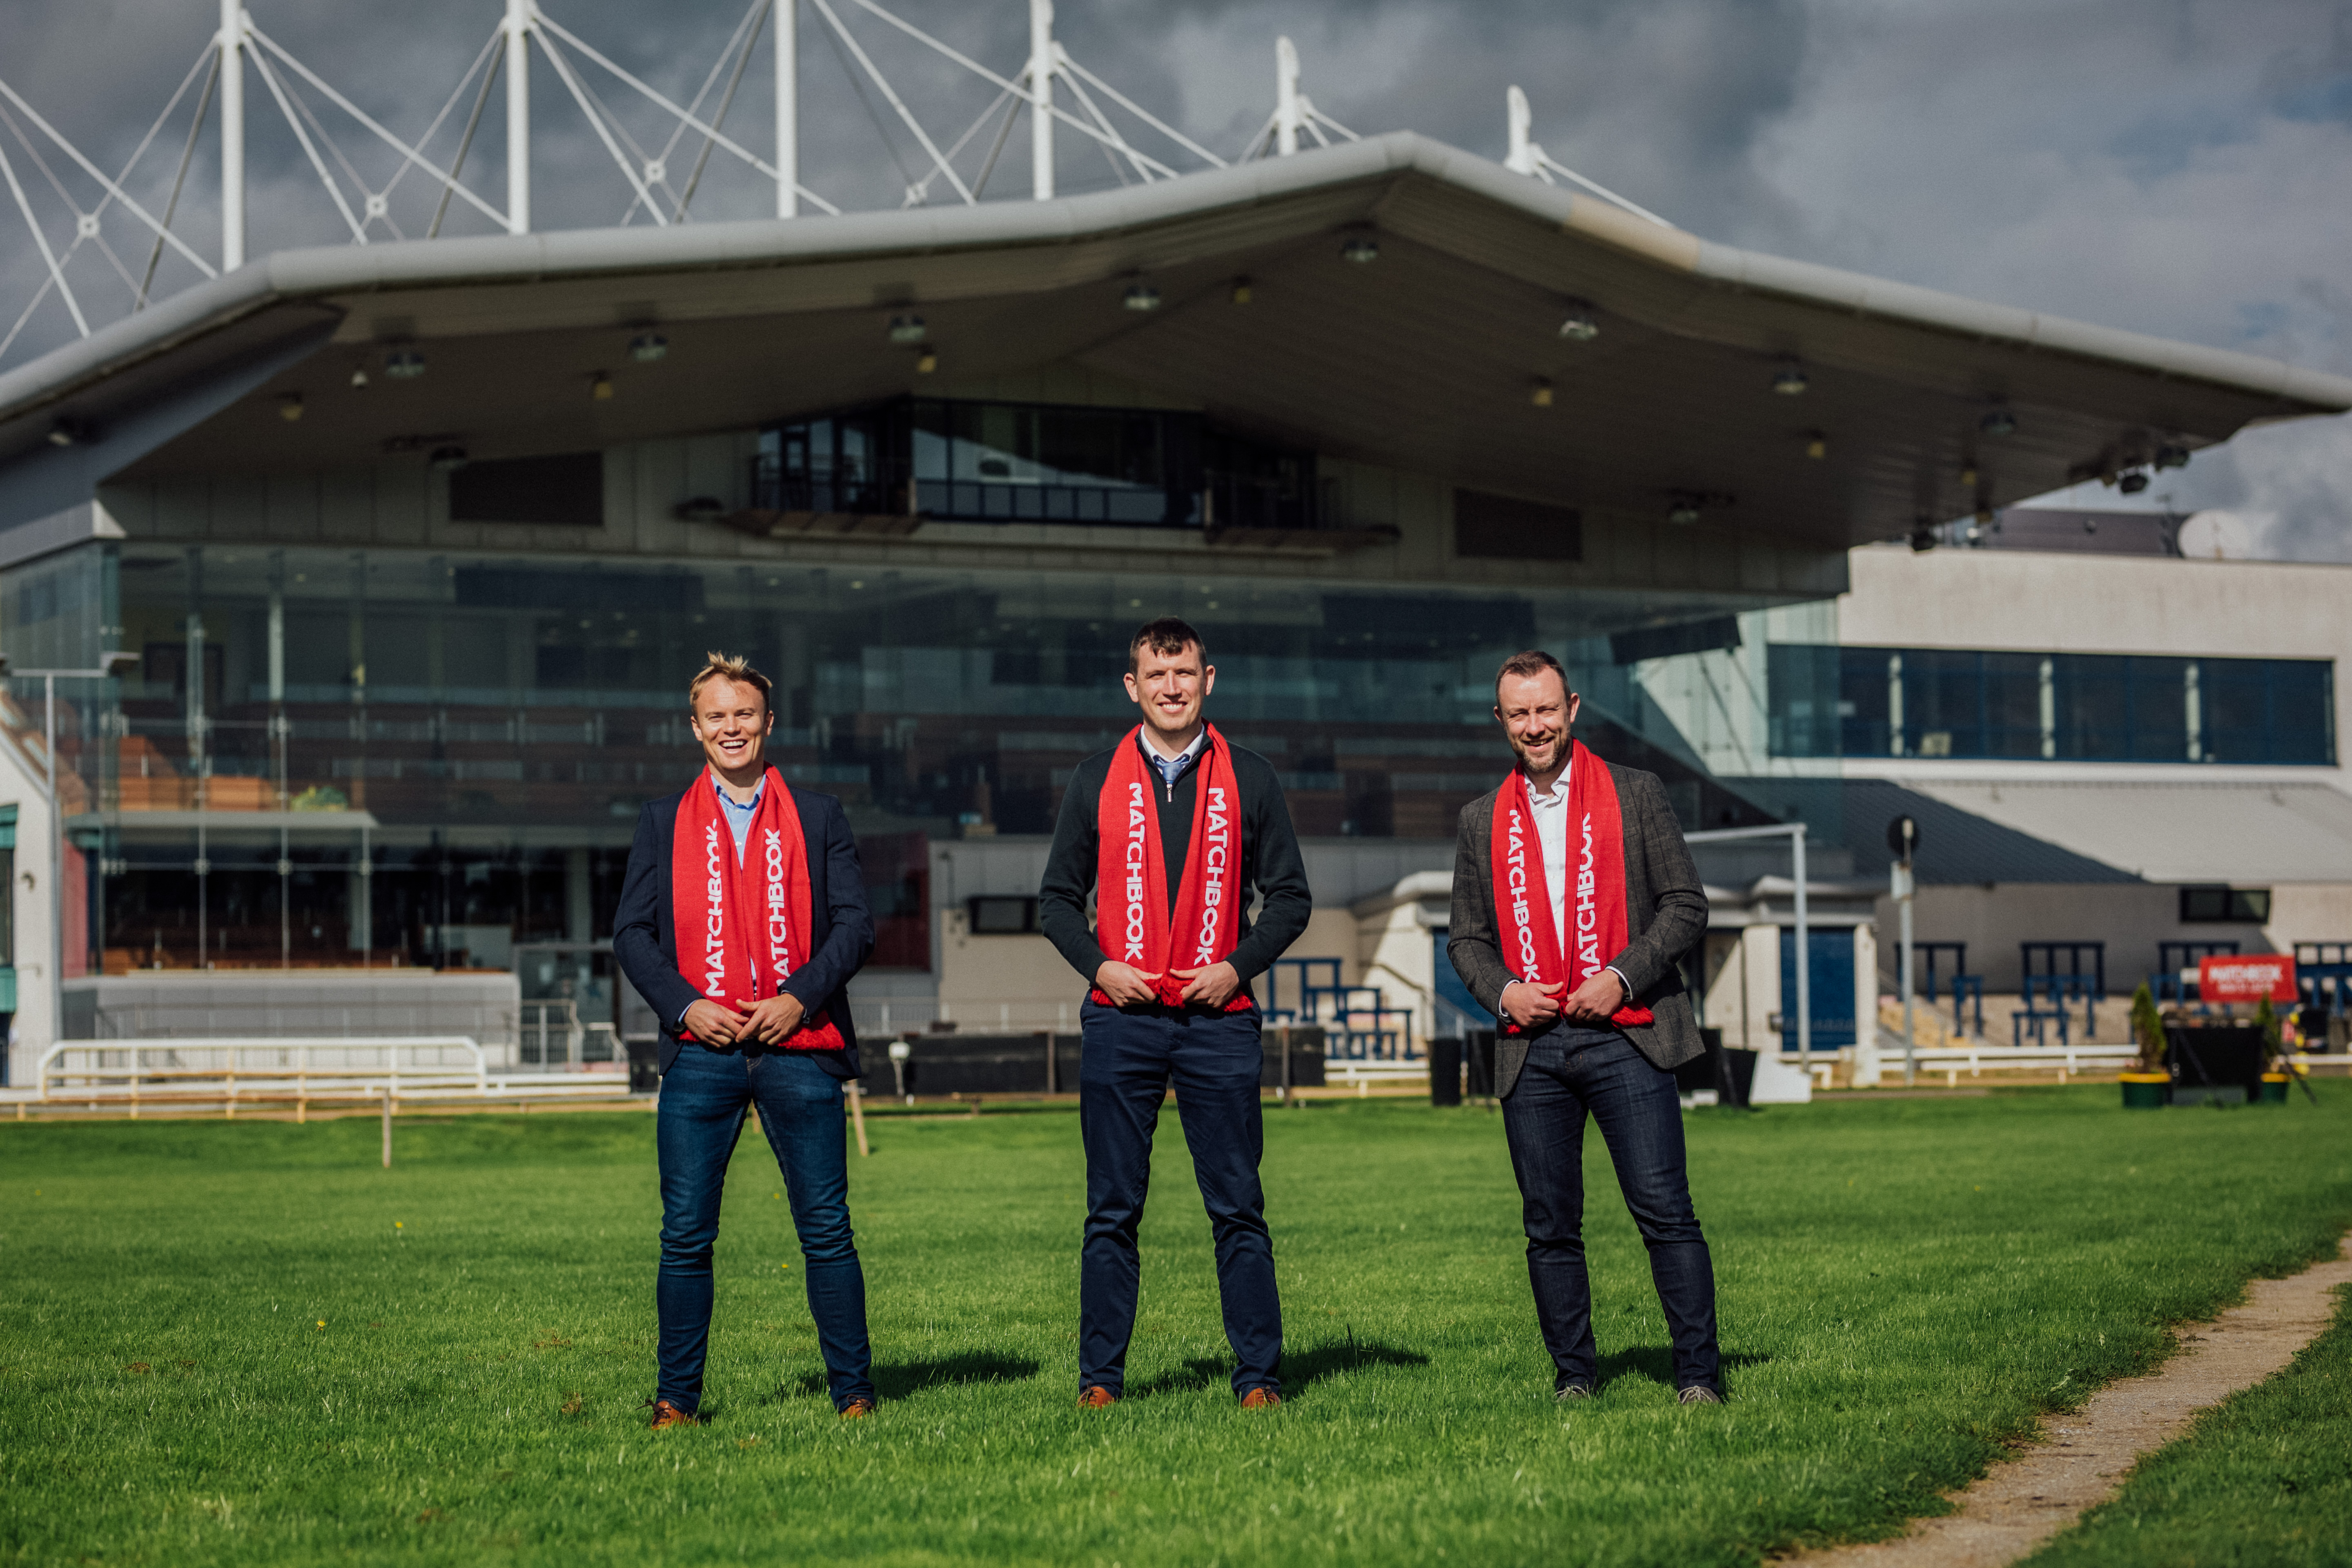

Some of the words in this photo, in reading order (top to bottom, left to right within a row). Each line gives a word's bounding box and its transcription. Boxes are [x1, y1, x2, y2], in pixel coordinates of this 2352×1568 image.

[705, 818, 725, 997] MATCHBOOK
[764, 828, 791, 986] ATCHBOOK
[1125, 782, 1145, 962] MATCHBOOK
[1194, 788, 1228, 966] MATCHBOOK
[1508, 809, 1541, 983] MATCHBOOK
